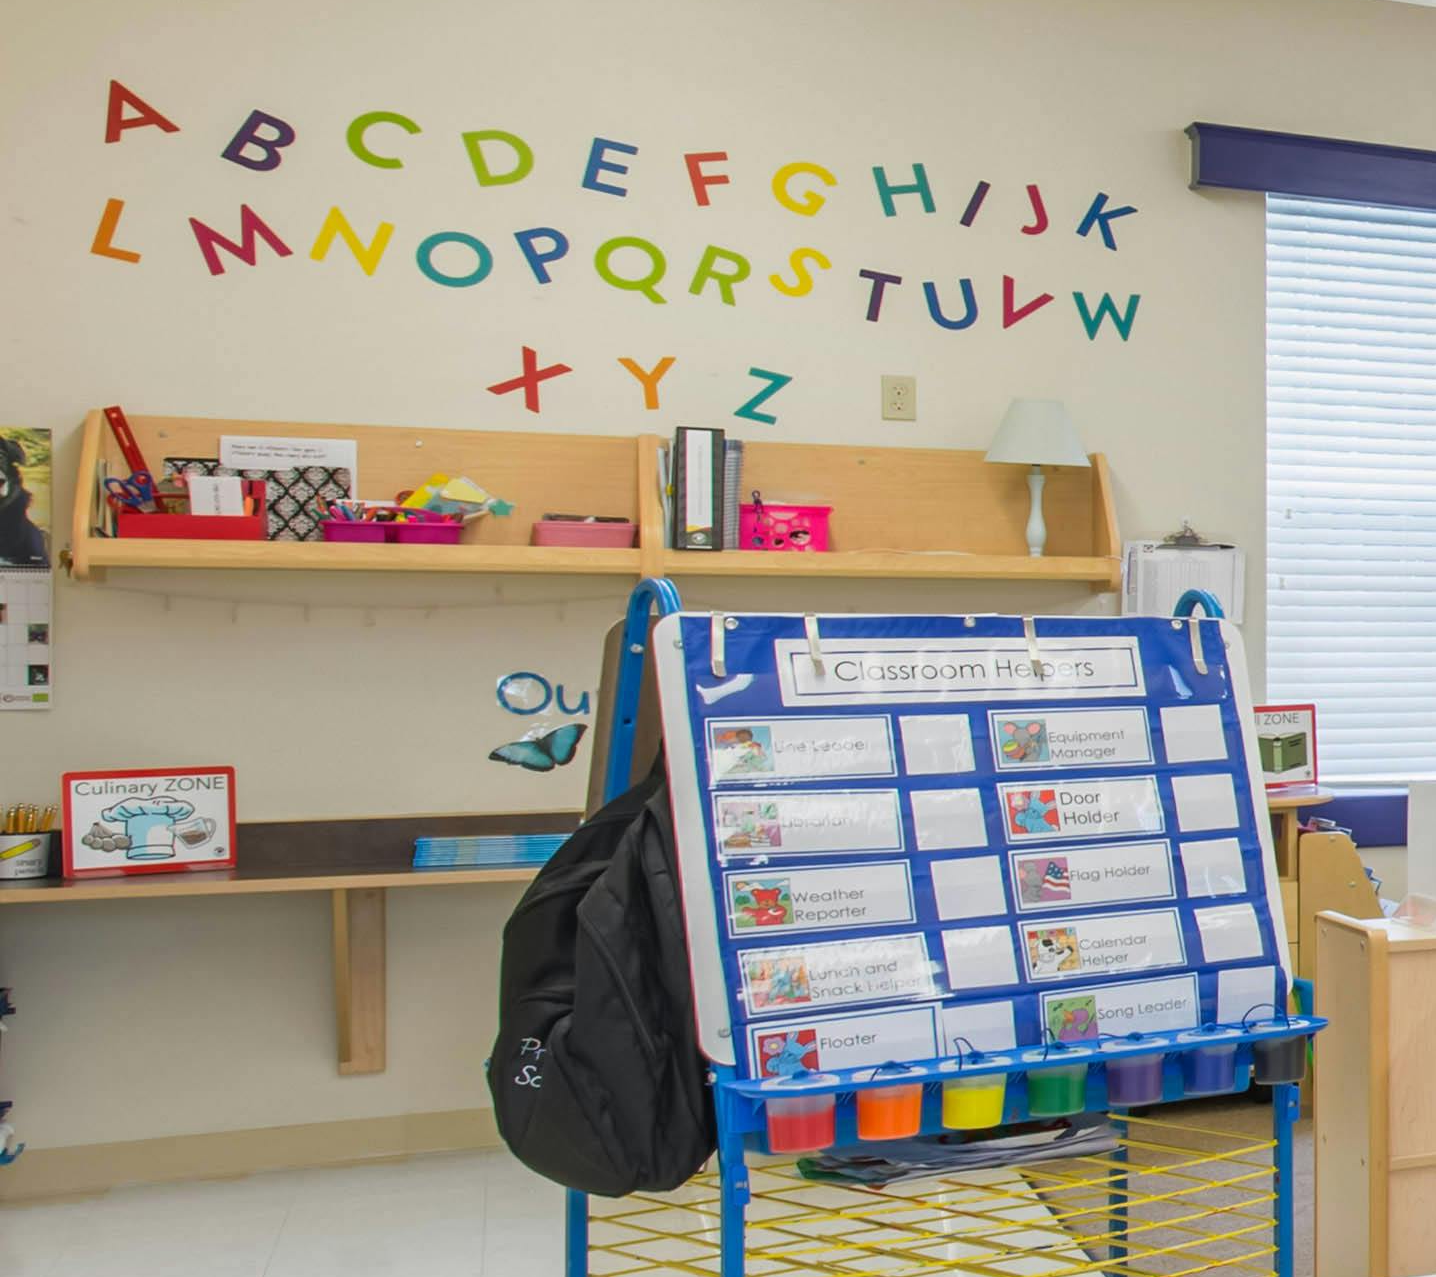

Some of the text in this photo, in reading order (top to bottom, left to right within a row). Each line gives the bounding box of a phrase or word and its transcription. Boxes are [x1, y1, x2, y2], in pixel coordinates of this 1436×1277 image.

[105, 80, 1139, 251] A B C D E F G H I J K
[90, 198, 1141, 342] L M N O P Q R S T U V W
[485, 345, 793, 426] X Y Z
[834, 659, 986, 683] Classroom
[1264, 713, 1300, 726] ZONE
[1048, 728, 1125, 746] Equipment
[1051, 745, 1116, 762] Manager
[74, 776, 225, 798] Culinary ZONE
[1060, 791, 1101, 806] Door
[1063, 809, 1120, 825] Holder
[1070, 864, 1151, 883] Flag Holder
[793, 888, 865, 904] Weather
[794, 906, 867, 923] Reporter
[1078, 934, 1148, 951] Calendar
[865, 961, 898, 974] and
[1081, 952, 1129, 967] Helper
[812, 981, 861, 999] Snack
[1097, 998, 1188, 1023] Song Leader
[820, 1033, 877, 1051] Floater
